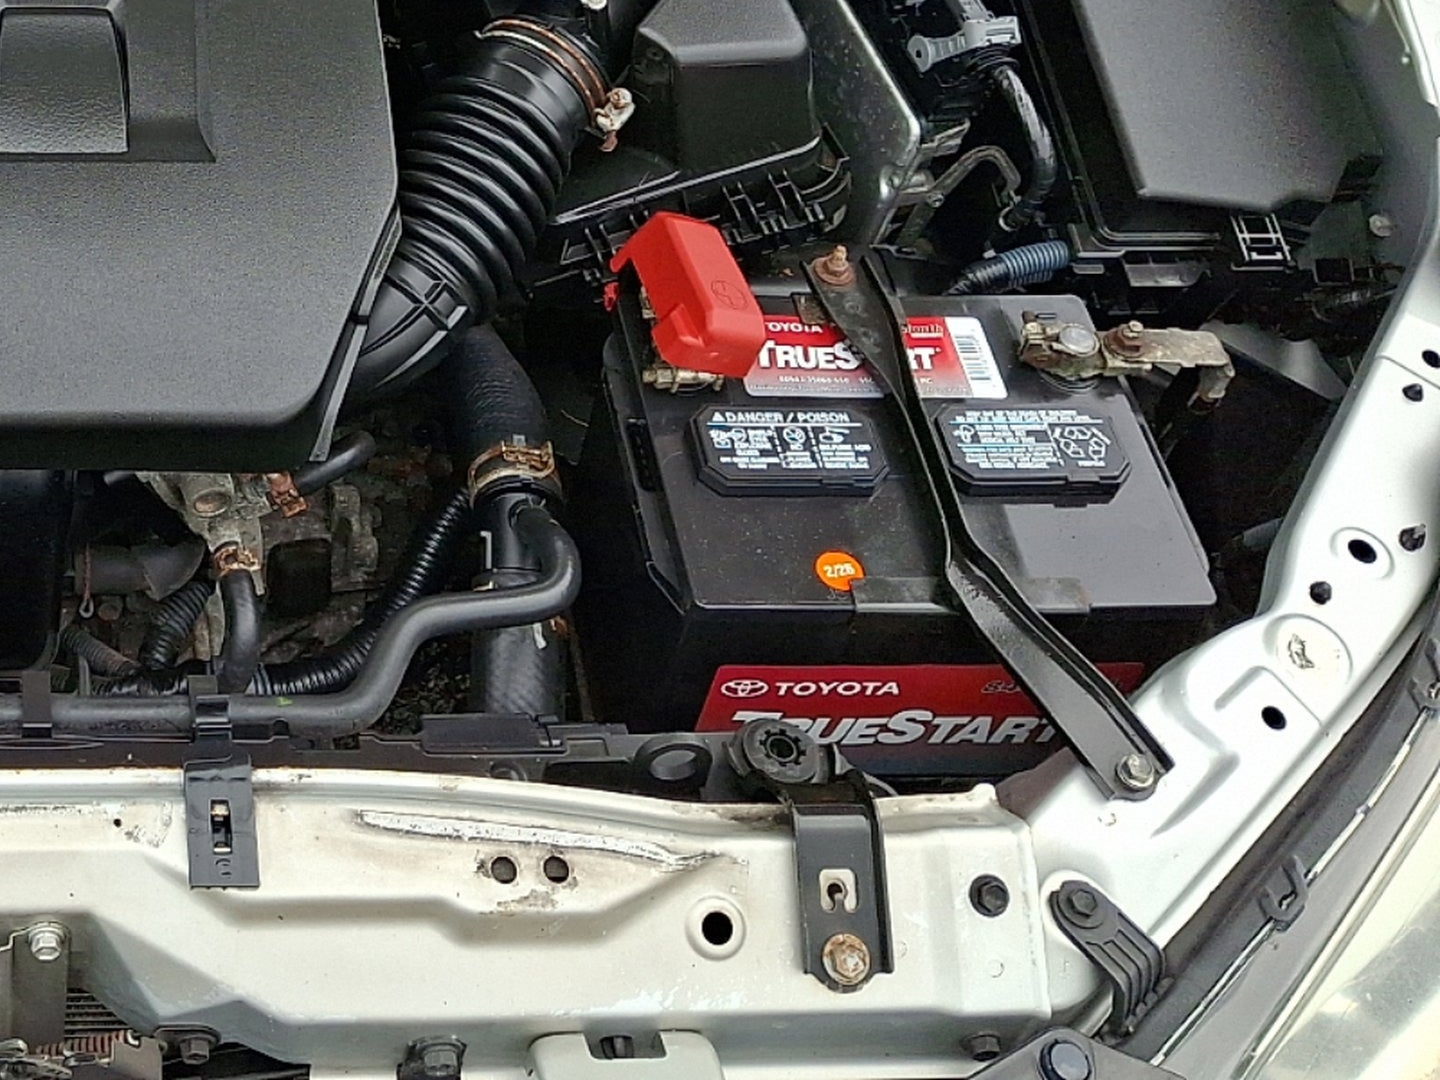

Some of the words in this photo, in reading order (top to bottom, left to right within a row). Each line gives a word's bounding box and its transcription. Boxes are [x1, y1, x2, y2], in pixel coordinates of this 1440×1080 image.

[725, 411, 784, 422] DANGER
[797, 412, 850, 422] POISON
[774, 681, 900, 696] TOYOTA
